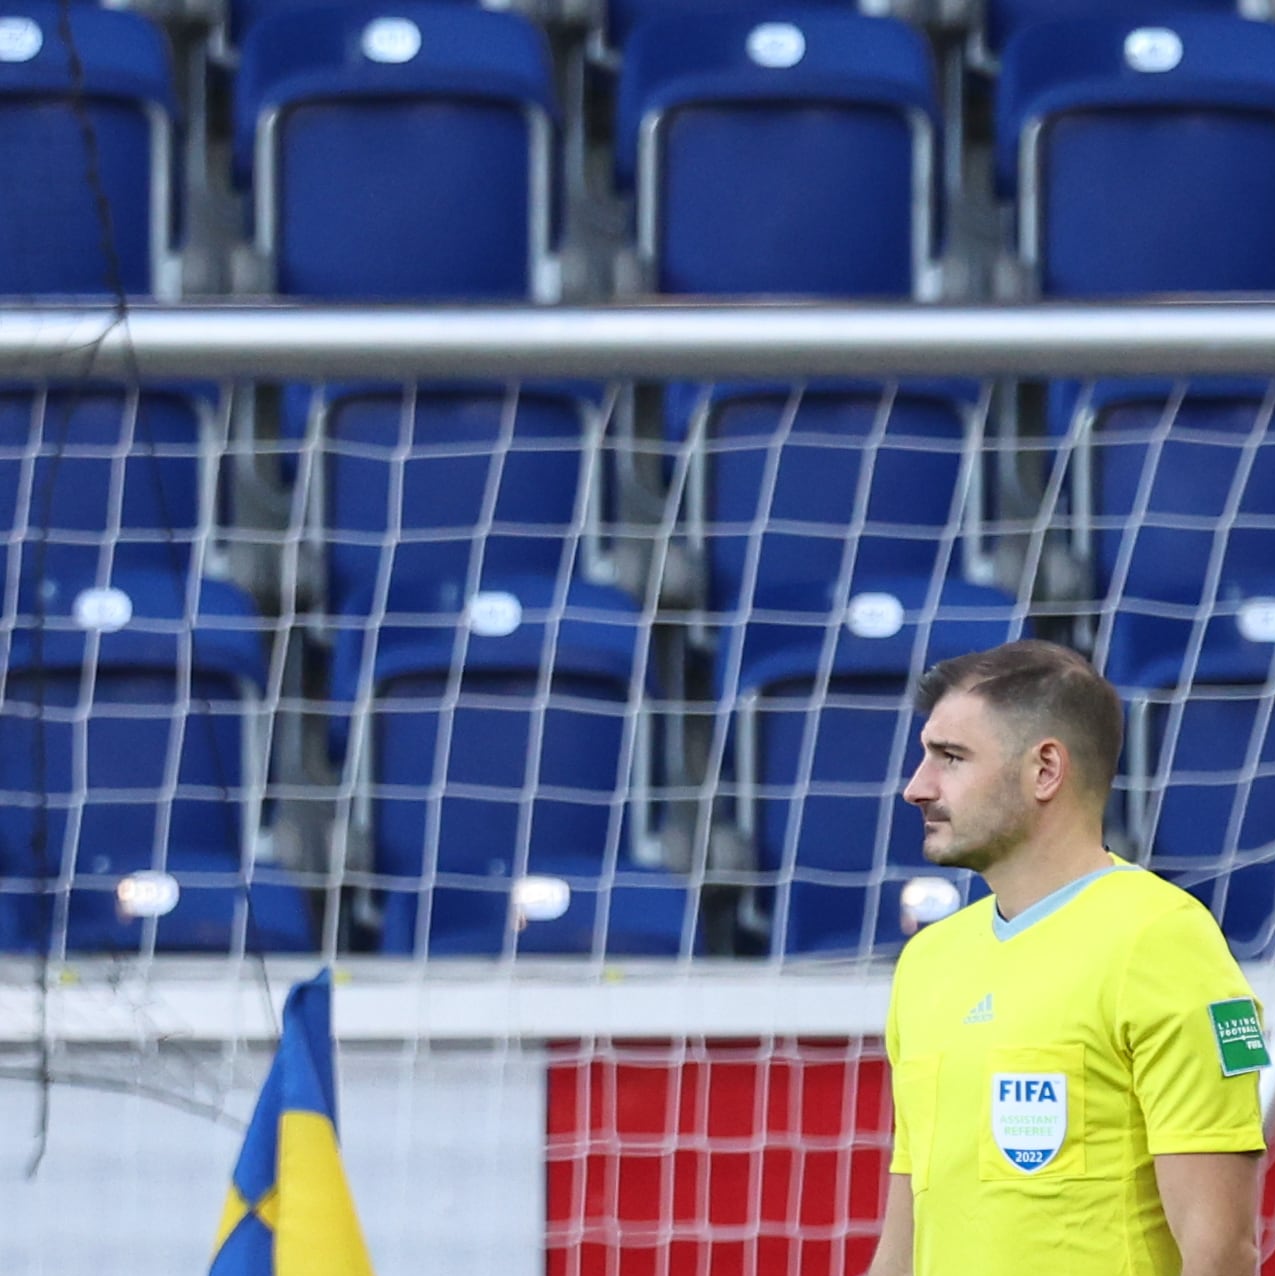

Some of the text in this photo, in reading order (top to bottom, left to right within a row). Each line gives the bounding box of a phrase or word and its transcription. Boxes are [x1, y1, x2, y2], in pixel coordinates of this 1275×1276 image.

[999, 1080, 1057, 1102] FIFA
[1000, 1115, 1059, 1125] ASSISTANT
[1004, 1127, 1054, 1137] REFEREE
[1015, 1152, 1044, 1162] 2022
